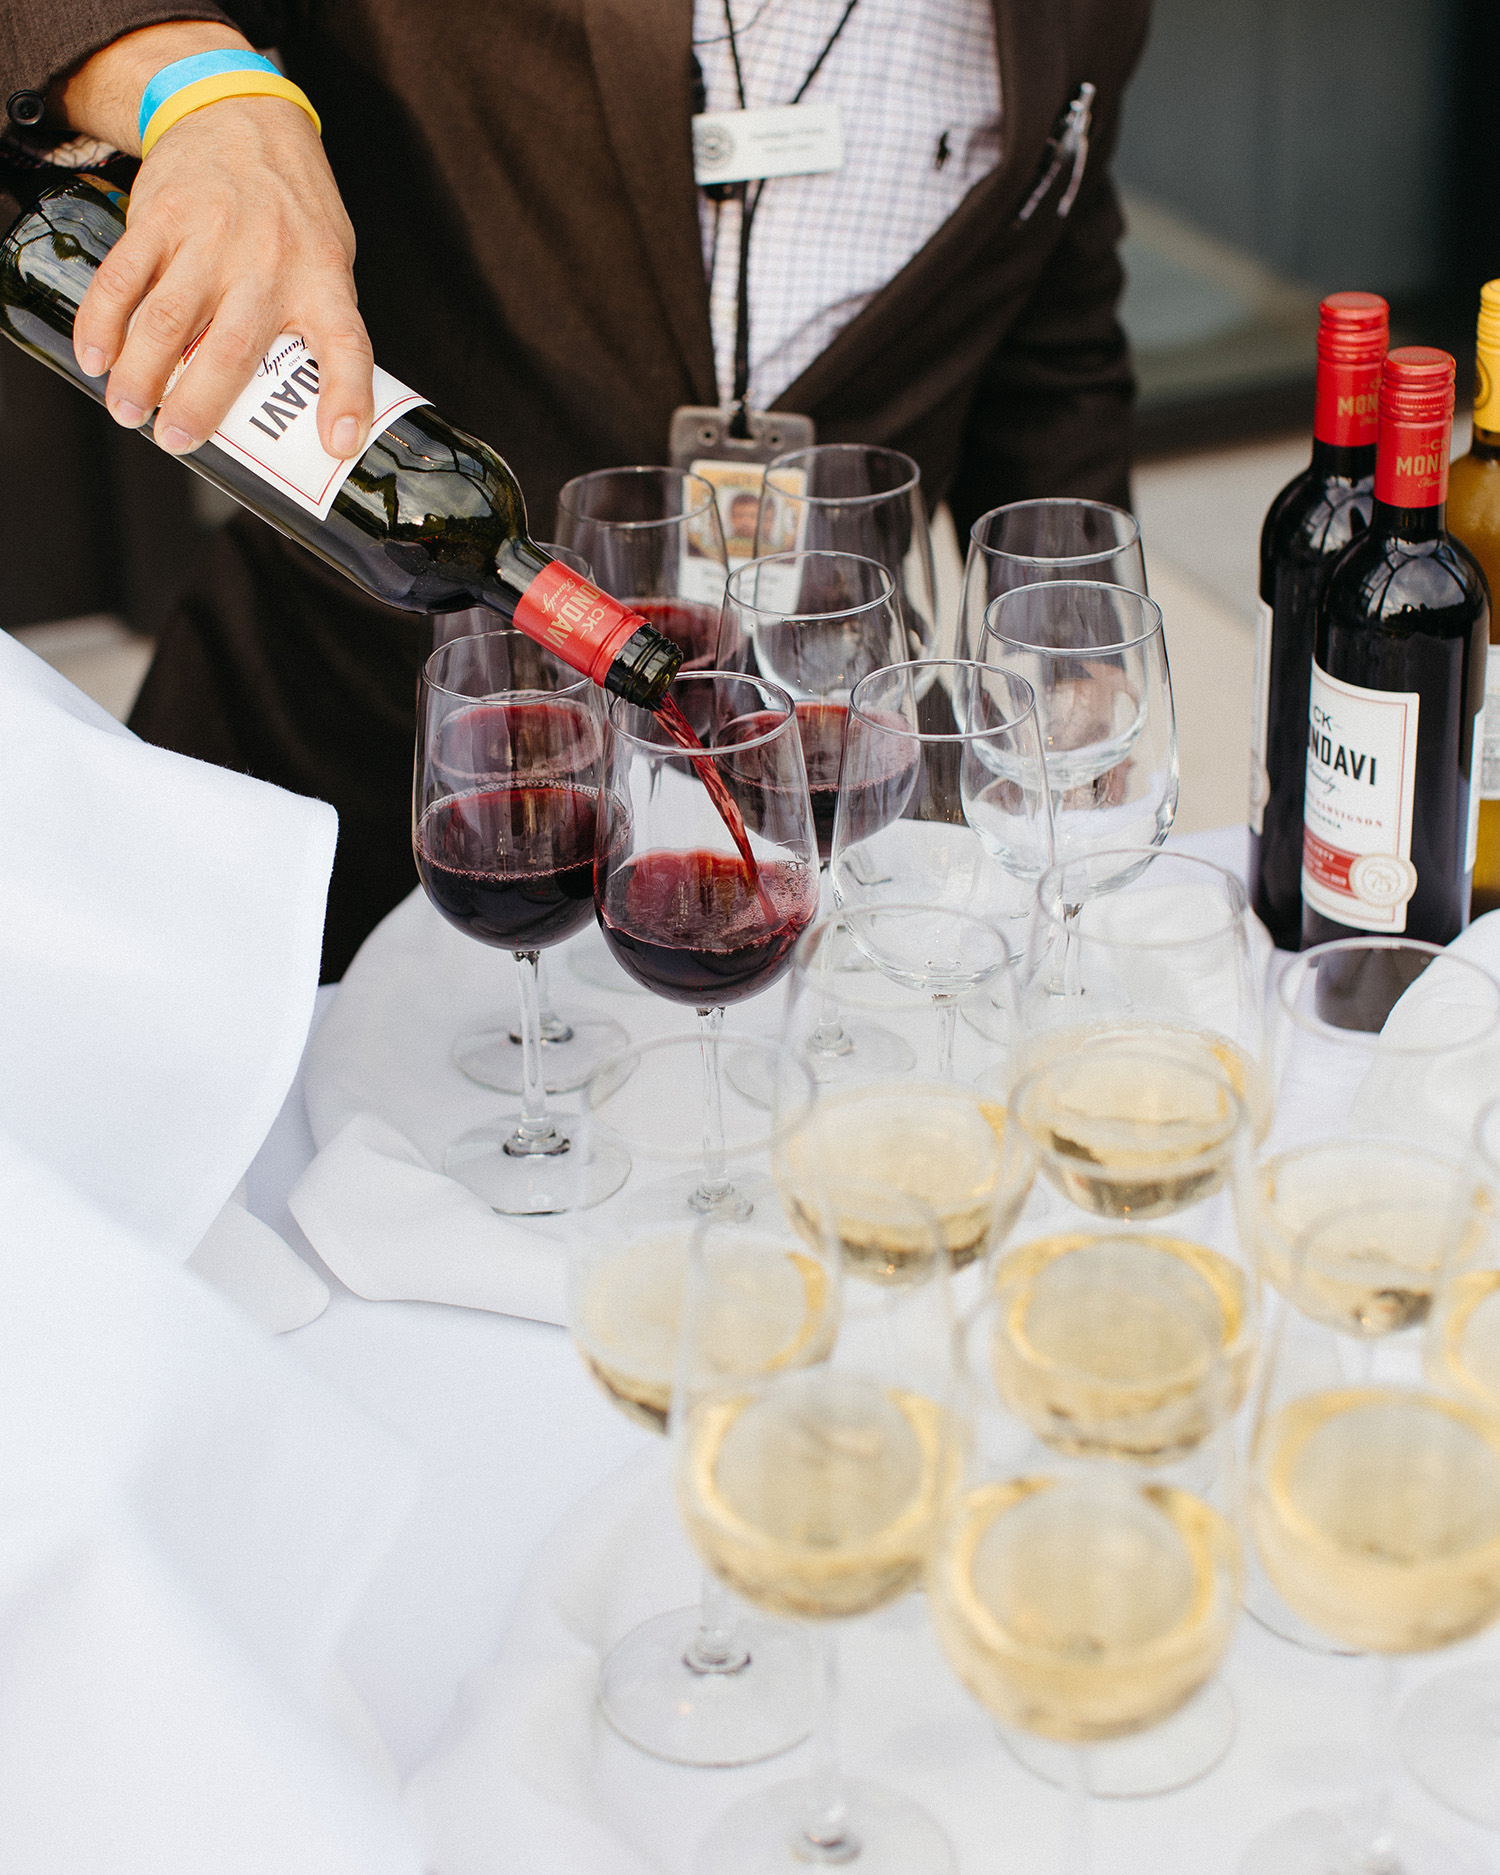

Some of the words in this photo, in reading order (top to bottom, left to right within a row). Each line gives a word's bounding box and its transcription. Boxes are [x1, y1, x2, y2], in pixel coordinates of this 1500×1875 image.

[249, 359, 320, 442] DAVI
[541, 577, 576, 614] Family
[543, 584, 601, 649] ONDAVI
[581, 608, 605, 632] CK
[1313, 705, 1332, 732] CK
[1307, 724, 1377, 786] NDAVI
